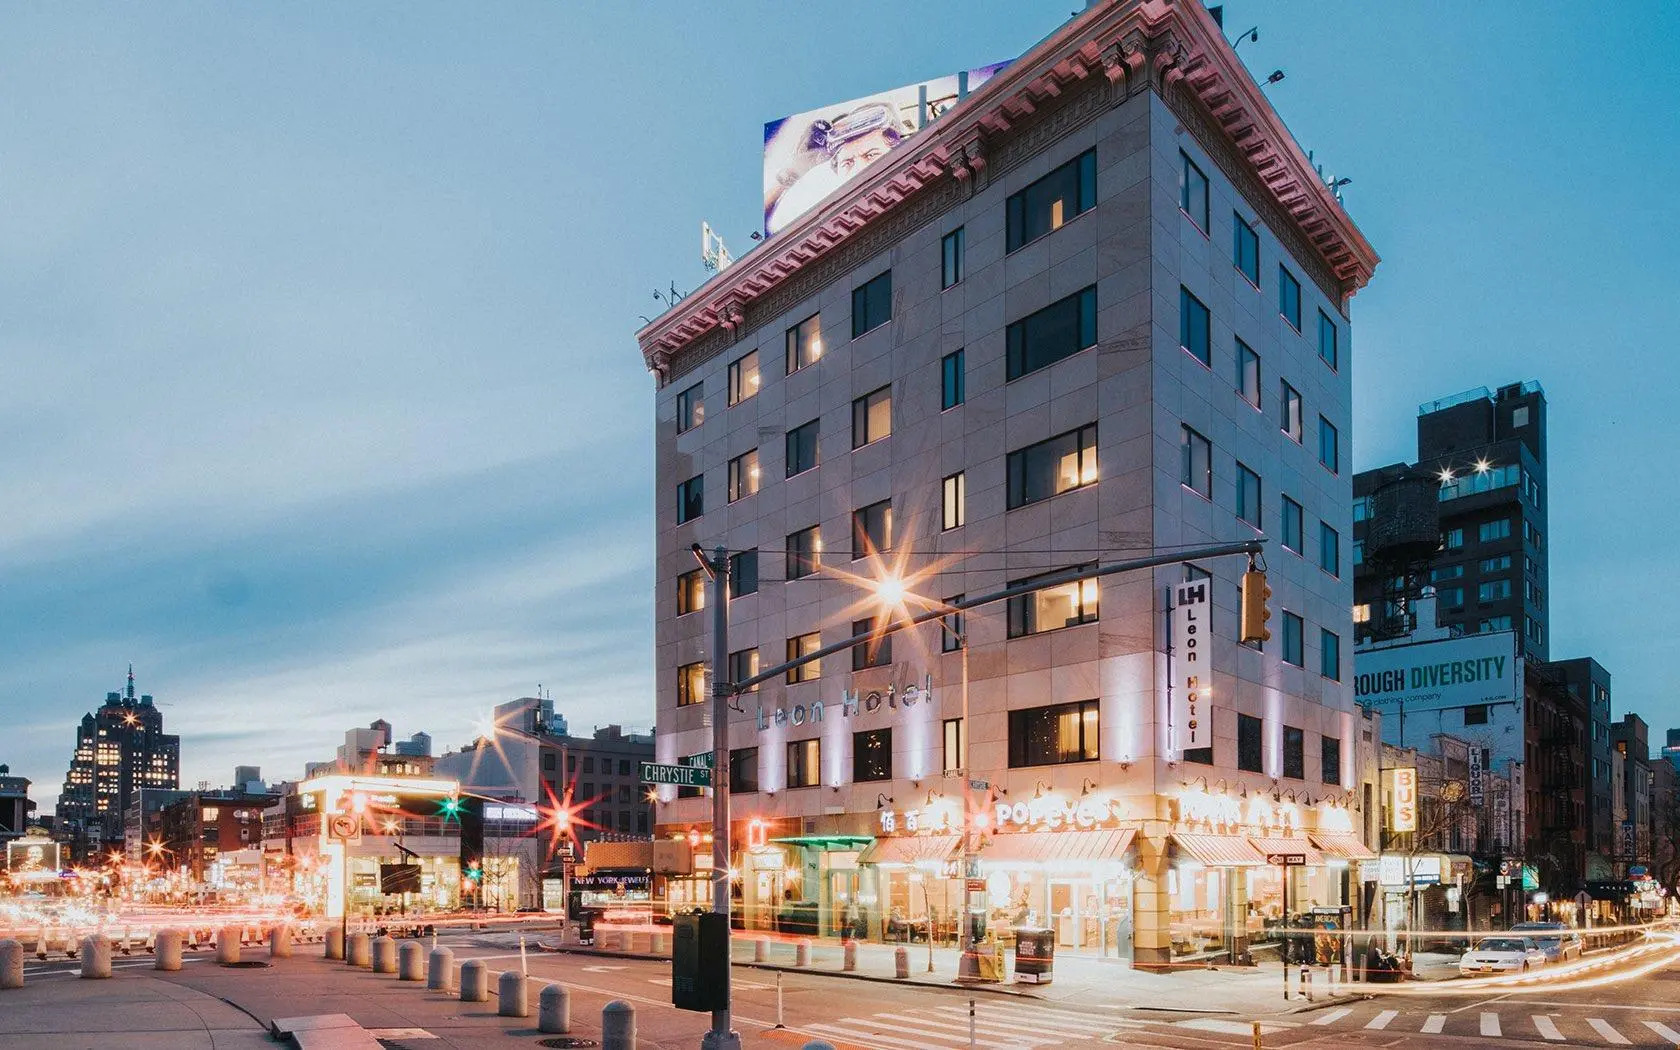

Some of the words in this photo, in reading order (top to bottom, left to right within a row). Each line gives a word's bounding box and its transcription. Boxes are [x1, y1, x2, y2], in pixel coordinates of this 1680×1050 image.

[1187, 609, 1197, 662] Leon
[1411, 656, 1506, 690] DIVERSITY
[757, 700, 825, 731] Leon
[842, 674, 932, 717] Hotel
[1187, 676, 1198, 743] Hotel
[1405, 692, 1442, 703] company
[645, 765, 695, 784] CHRYSTIE
[700, 770, 709, 778] ST
[689, 753, 708, 768] CANAL
[1470, 748, 1482, 795] LIQUOR
[1398, 771, 1412, 822] BUS
[574, 876, 595, 885] NEW
[597, 876, 618, 885] YORK
